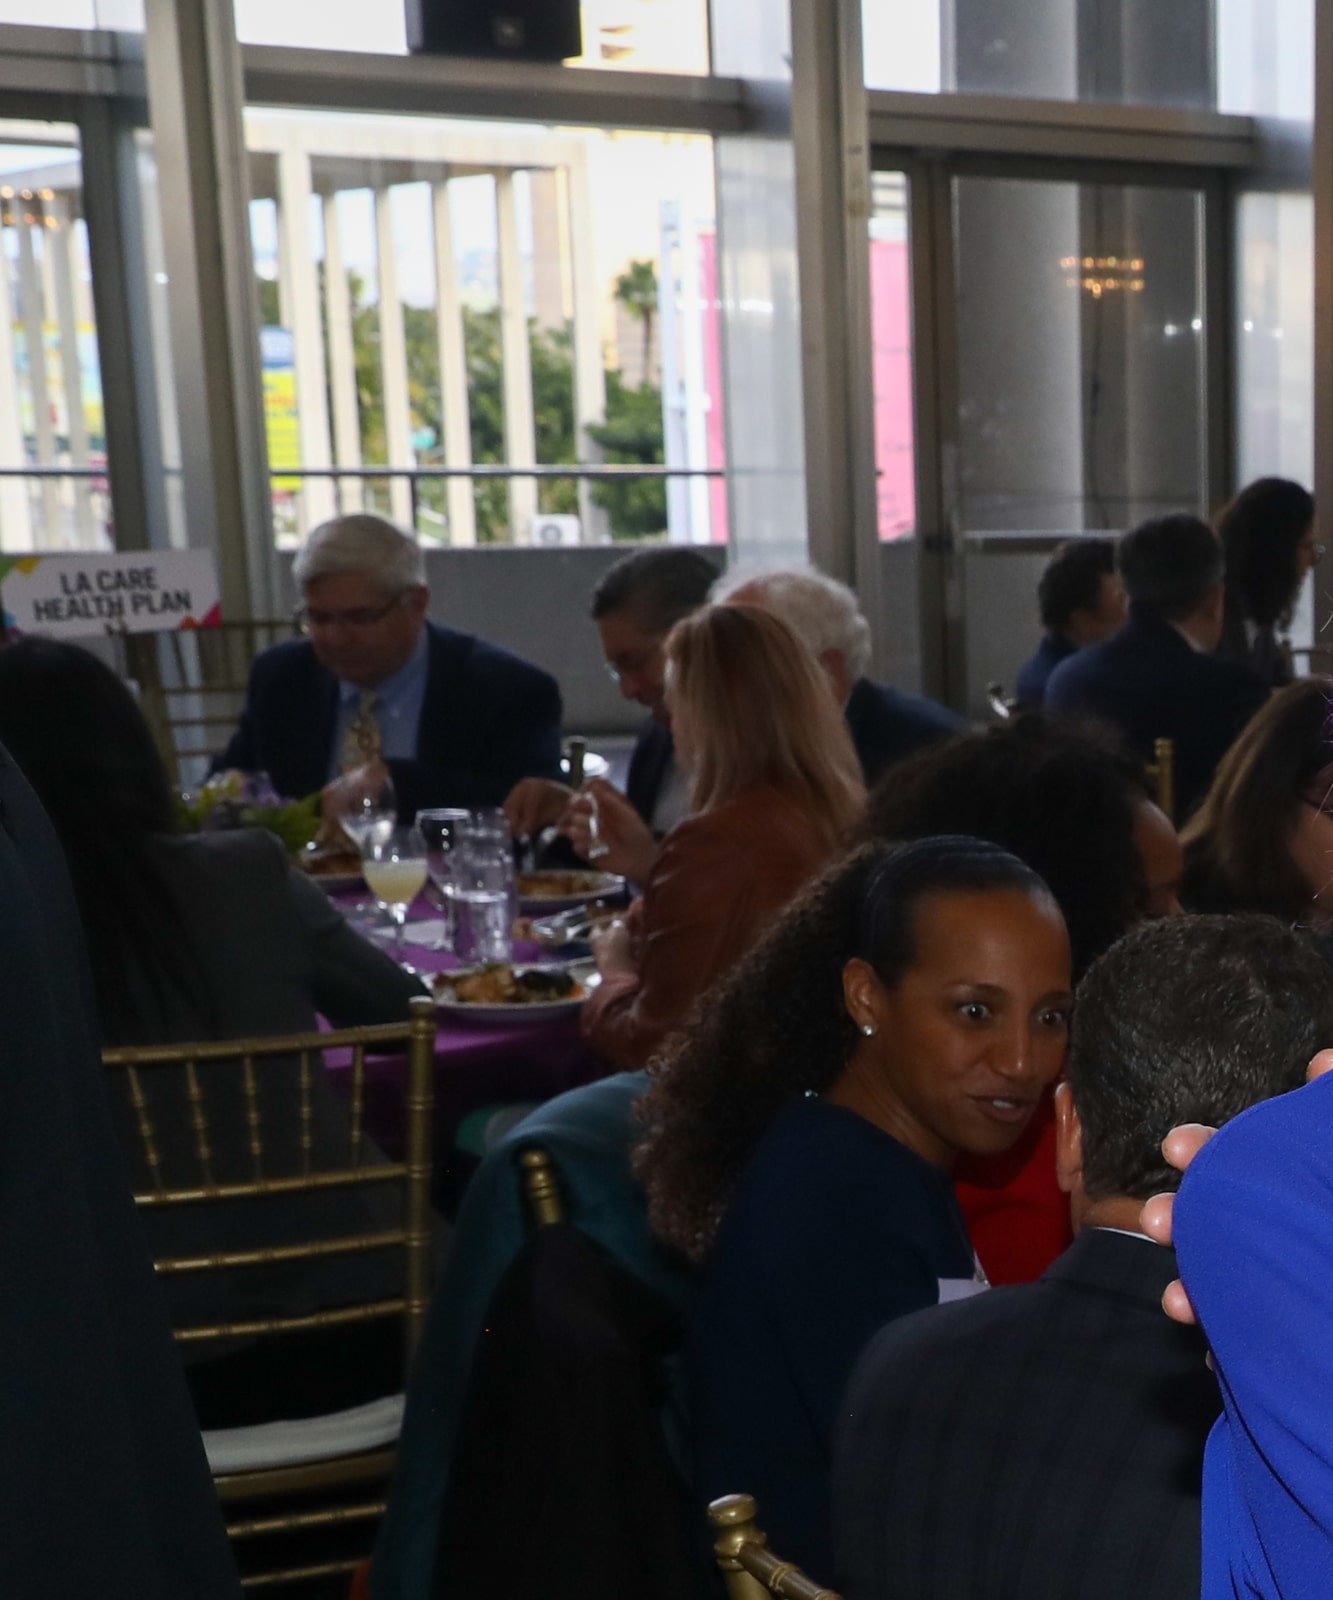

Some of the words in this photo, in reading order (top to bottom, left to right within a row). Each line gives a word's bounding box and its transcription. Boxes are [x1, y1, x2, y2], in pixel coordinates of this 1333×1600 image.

[60, 571, 92, 595] LA
[96, 567, 158, 592] CARE
[33, 595, 125, 621] HEALTH
[131, 590, 192, 616] PLAN
